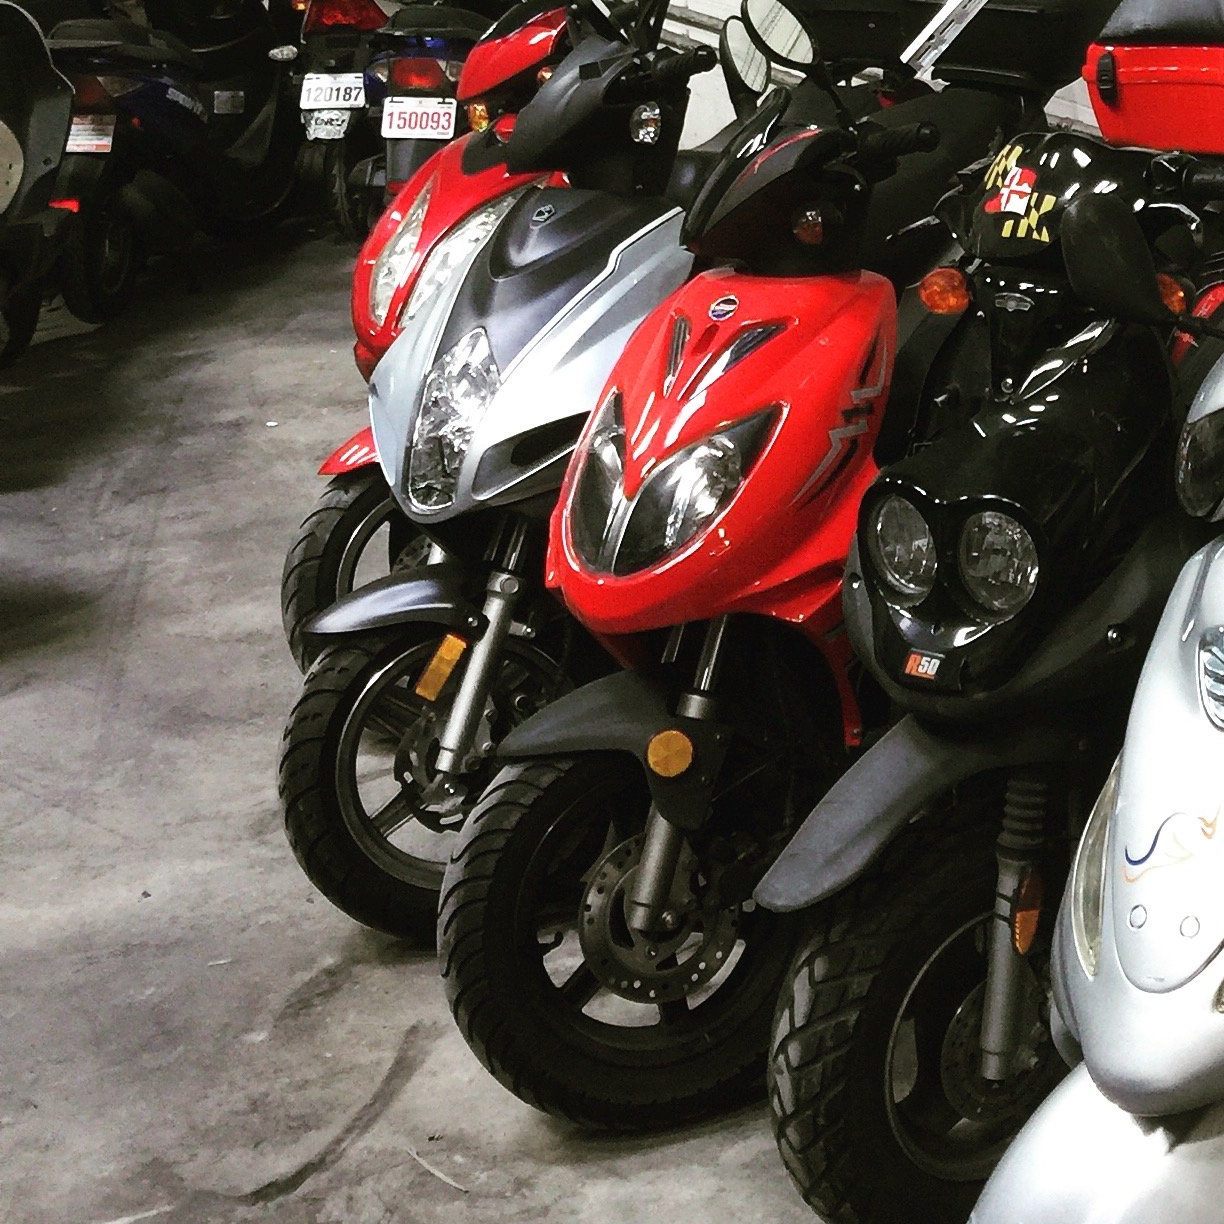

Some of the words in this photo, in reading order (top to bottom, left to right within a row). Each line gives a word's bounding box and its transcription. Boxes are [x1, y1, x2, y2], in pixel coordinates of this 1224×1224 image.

[306, 86, 363, 103] 120187
[387, 111, 452, 131] 150093
[905, 653, 941, 676] R50
